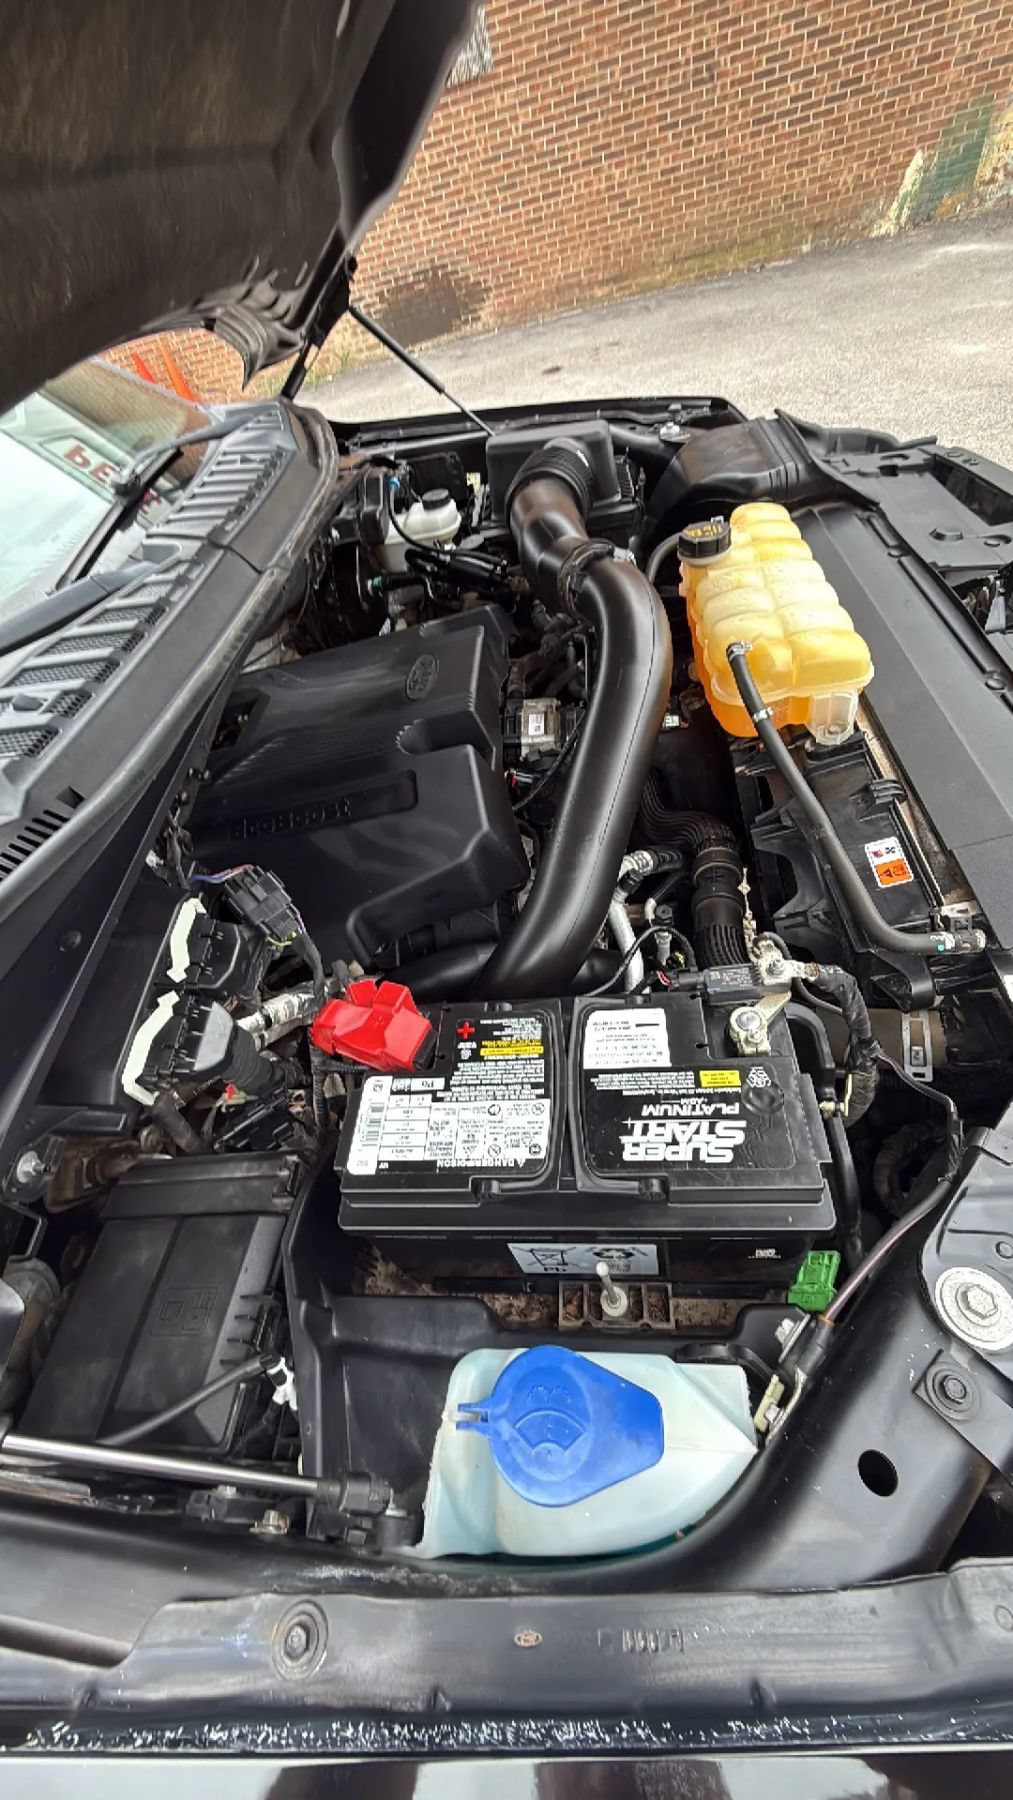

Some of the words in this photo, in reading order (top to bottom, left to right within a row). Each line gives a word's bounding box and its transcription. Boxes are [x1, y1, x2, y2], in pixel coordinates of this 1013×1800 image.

[641, 1102, 740, 1116] PLATINUM
[619, 1120, 747, 1146] START
[622, 1141, 734, 1164] SUPER
